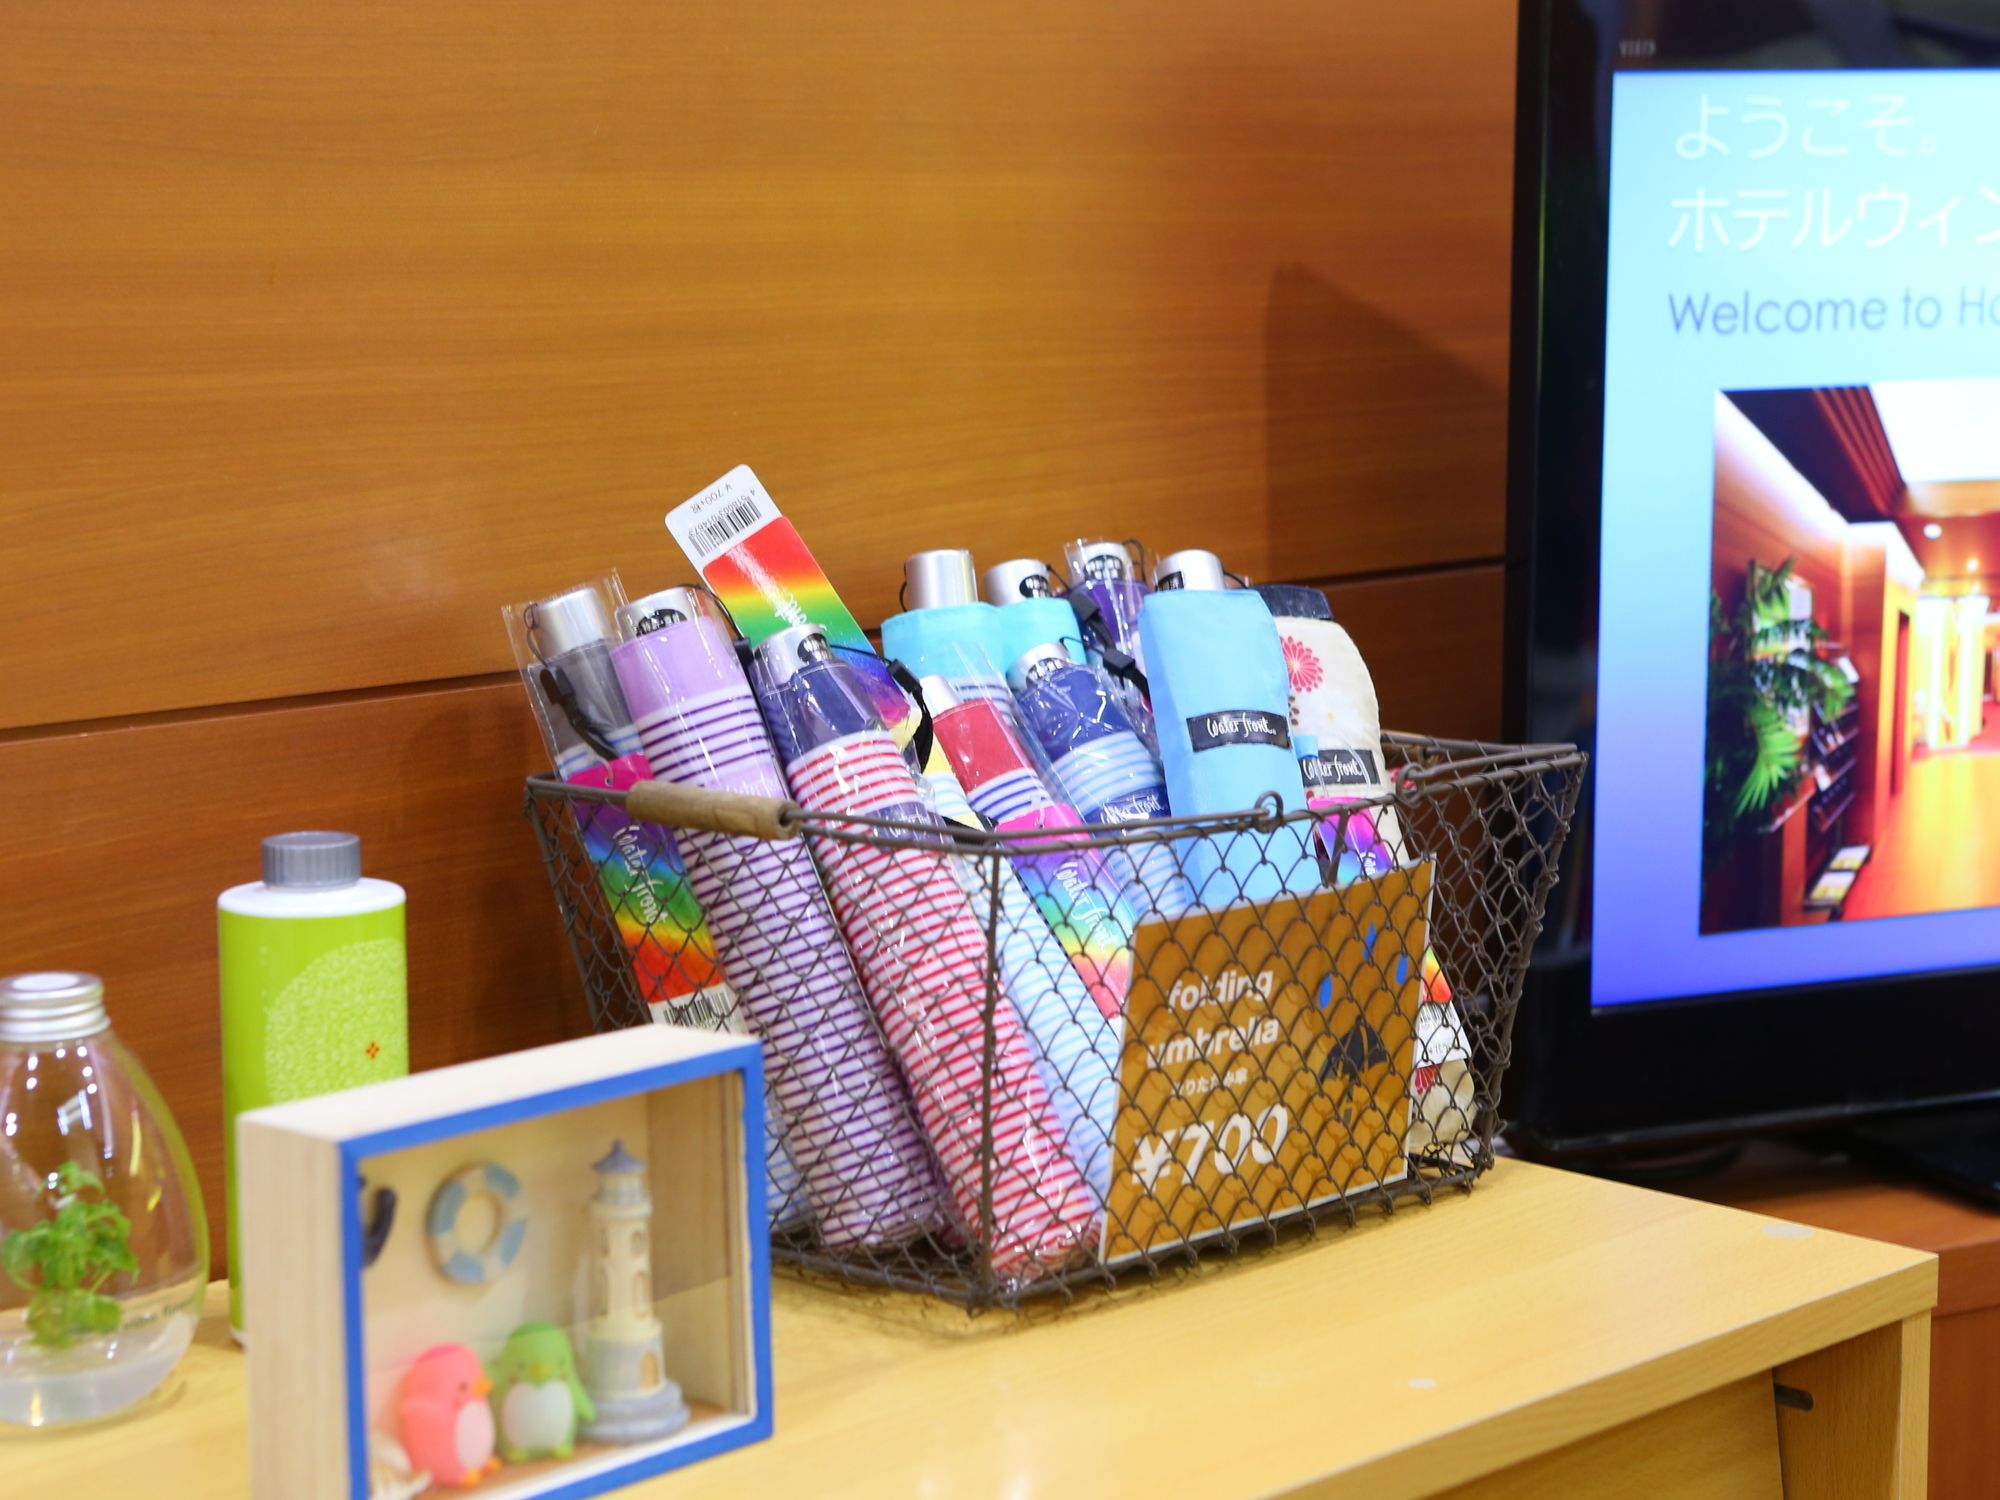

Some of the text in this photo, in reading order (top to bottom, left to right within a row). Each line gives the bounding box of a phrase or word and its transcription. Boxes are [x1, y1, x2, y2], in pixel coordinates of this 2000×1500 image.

[1675, 93, 1938, 159] ようこそ。
[1667, 289, 1887, 336] Welcome
[1903, 286, 1942, 329] to
[1206, 717, 1240, 739] Water
[1167, 970, 1274, 1013] folding
[1146, 1017, 1280, 1069] umbrella
[1131, 1102, 1289, 1195] ¥700
